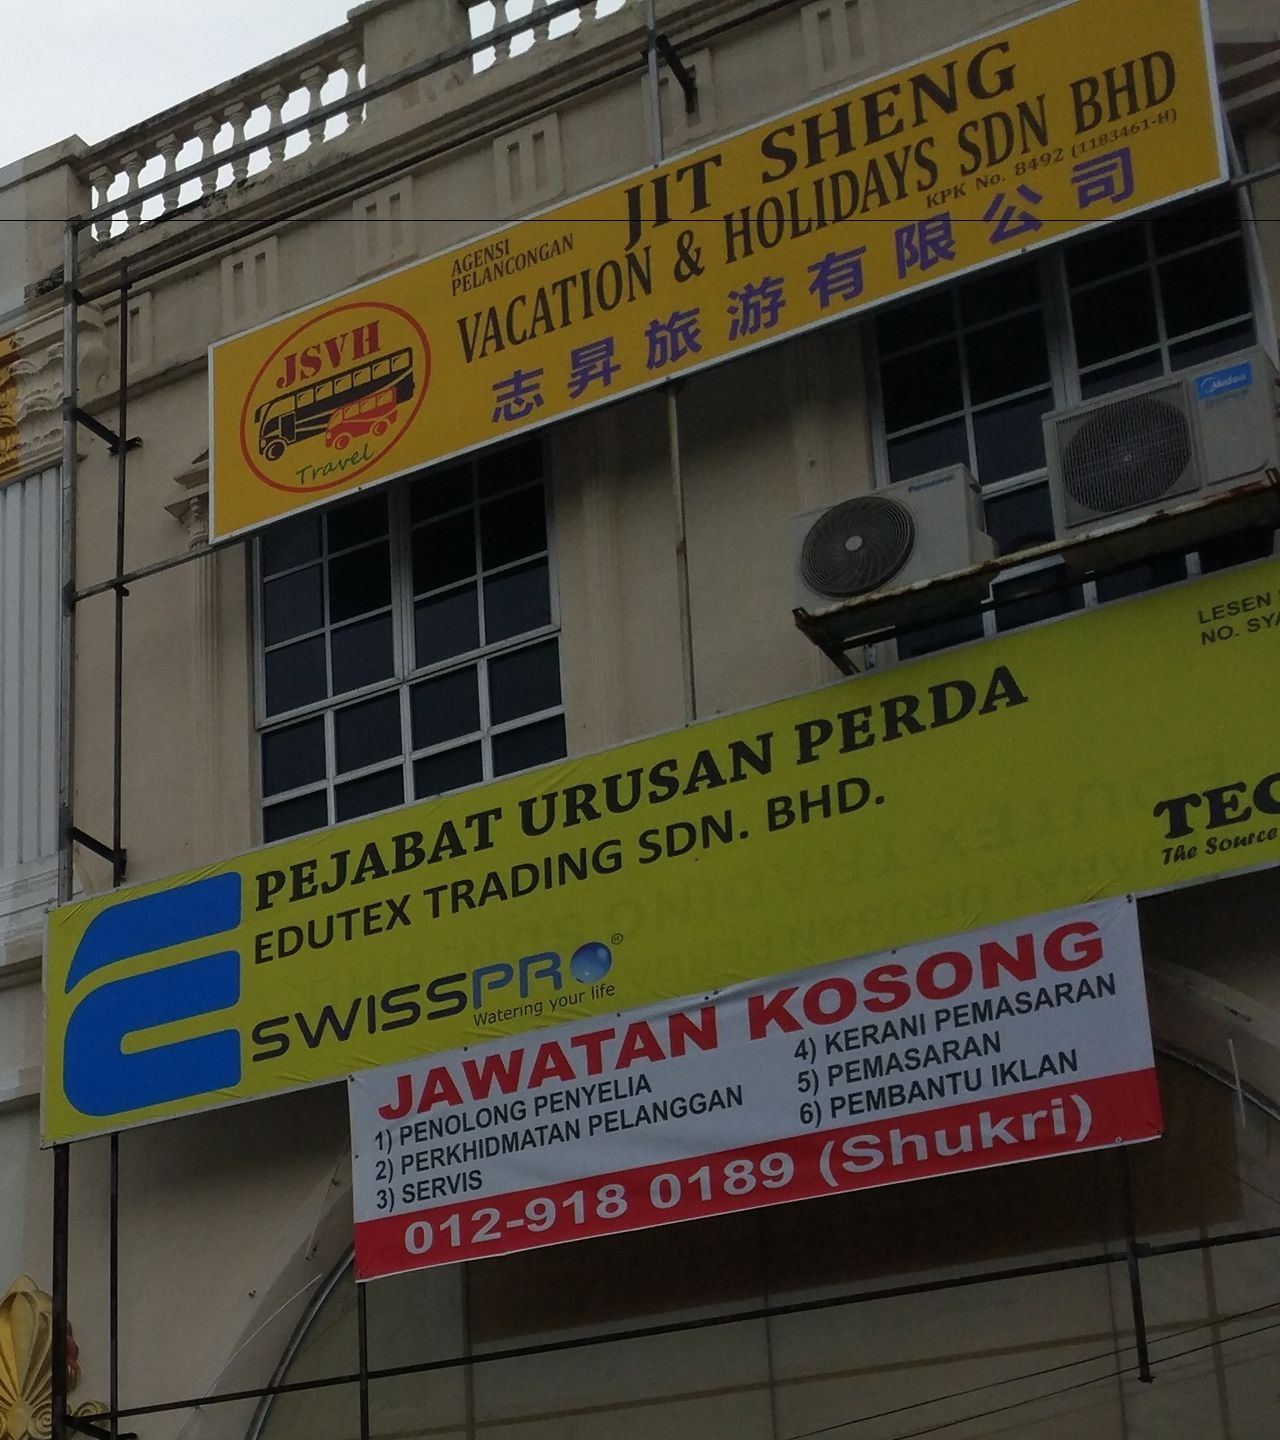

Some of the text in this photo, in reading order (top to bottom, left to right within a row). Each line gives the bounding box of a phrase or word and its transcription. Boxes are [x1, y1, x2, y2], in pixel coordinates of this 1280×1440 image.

[624, 42, 1017, 251] JIT SHENG
[926, 183, 968, 209] KPK
[976, 169, 1006, 191] No.
[1015, 148, 1064, 177] 8492
[457, 49, 1176, 363] VACATION & HOLIDAYS SDN BHD
[452, 239, 510, 276] AGENSI
[452, 233, 573, 296] PELANCONGAN
[492, 147, 1135, 424] 志昇旅游有限公司
[276, 321, 380, 388] JSVH
[296, 442, 375, 485] Travel
[1198, 592, 1272, 624] LESEN
[1200, 624, 1240, 645] NO.
[255, 665, 1029, 912] PEJABAT URUSAN PERDA
[255, 776, 885, 965] EDUTEX TRADING SDN. BHD.
[1162, 827, 1279, 866] The Source
[378, 921, 1104, 1121] JAWATAN KOSONG
[473, 984, 616, 1028] Watering your life
[794, 973, 1117, 1065] 4) KERANI PEMASARAN
[797, 1031, 1001, 1097] 5) PEMASARAN
[799, 1049, 1078, 1128] 6) PEMBANTU IKLAN
[375, 1073, 652, 1155] 1) PENOLONG PENYELIA
[375, 1084, 743, 1185] 2) PERKHIDMATAN PELANGGAN
[376, 1170, 483, 1213] 3) SERVIS
[404, 1094, 1092, 1256] 012-918 0189 (Shukri)
